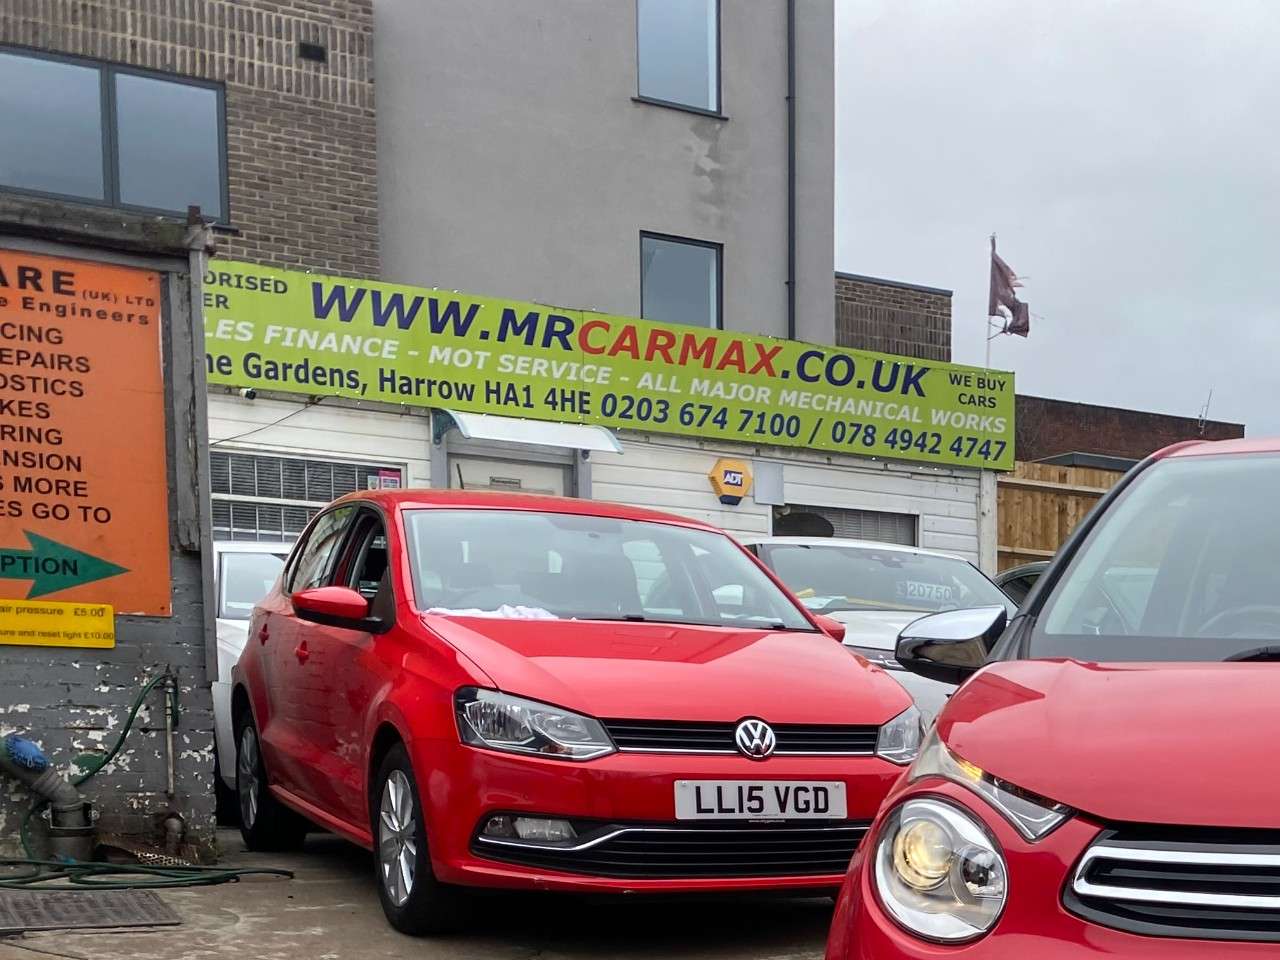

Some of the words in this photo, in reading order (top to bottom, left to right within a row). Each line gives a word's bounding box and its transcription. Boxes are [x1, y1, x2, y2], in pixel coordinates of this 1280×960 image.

[22, 296, 149, 325] Engineers
[125, 295, 155, 307] LTD
[0, 322, 64, 345] CING
[311, 281, 931, 398] WWW.MRCARMAX.CO.UK
[950, 373, 972, 388] WE
[977, 377, 1006, 392] BUY
[264, 324, 400, 360] FINANCE
[428, 345, 491, 370] MOT
[497, 354, 612, 385] SERVICE
[637, 371, 682, 394] ALL
[690, 377, 772, 405] MAJOR
[779, 389, 923, 424] MECHANICAL
[931, 409, 1007, 434] WORKS
[0, 398, 51, 419] KES
[243, 352, 368, 396] Gardens,
[379, 367, 475, 403] Harrow
[485, 380, 534, 409] HA1
[544, 387, 591, 415] 4HE
[601, 393, 670, 424] 0203
[679, 402, 728, 430] 674
[738, 409, 801, 439] 7100
[831, 420, 877, 448] 078
[884, 427, 942, 455] 4942
[949, 435, 1007, 462] 4747
[958, 393, 996, 408] CARS
[0, 424, 63, 446] RING
[13, 475, 88, 498] MORE
[724, 472, 743, 485] ADT
[32, 502, 70, 521] GO
[77, 505, 111, 524] TO
[0, 554, 78, 576] PTION
[695, 785, 764, 814] LL15
[774, 785, 829, 814] VGD
